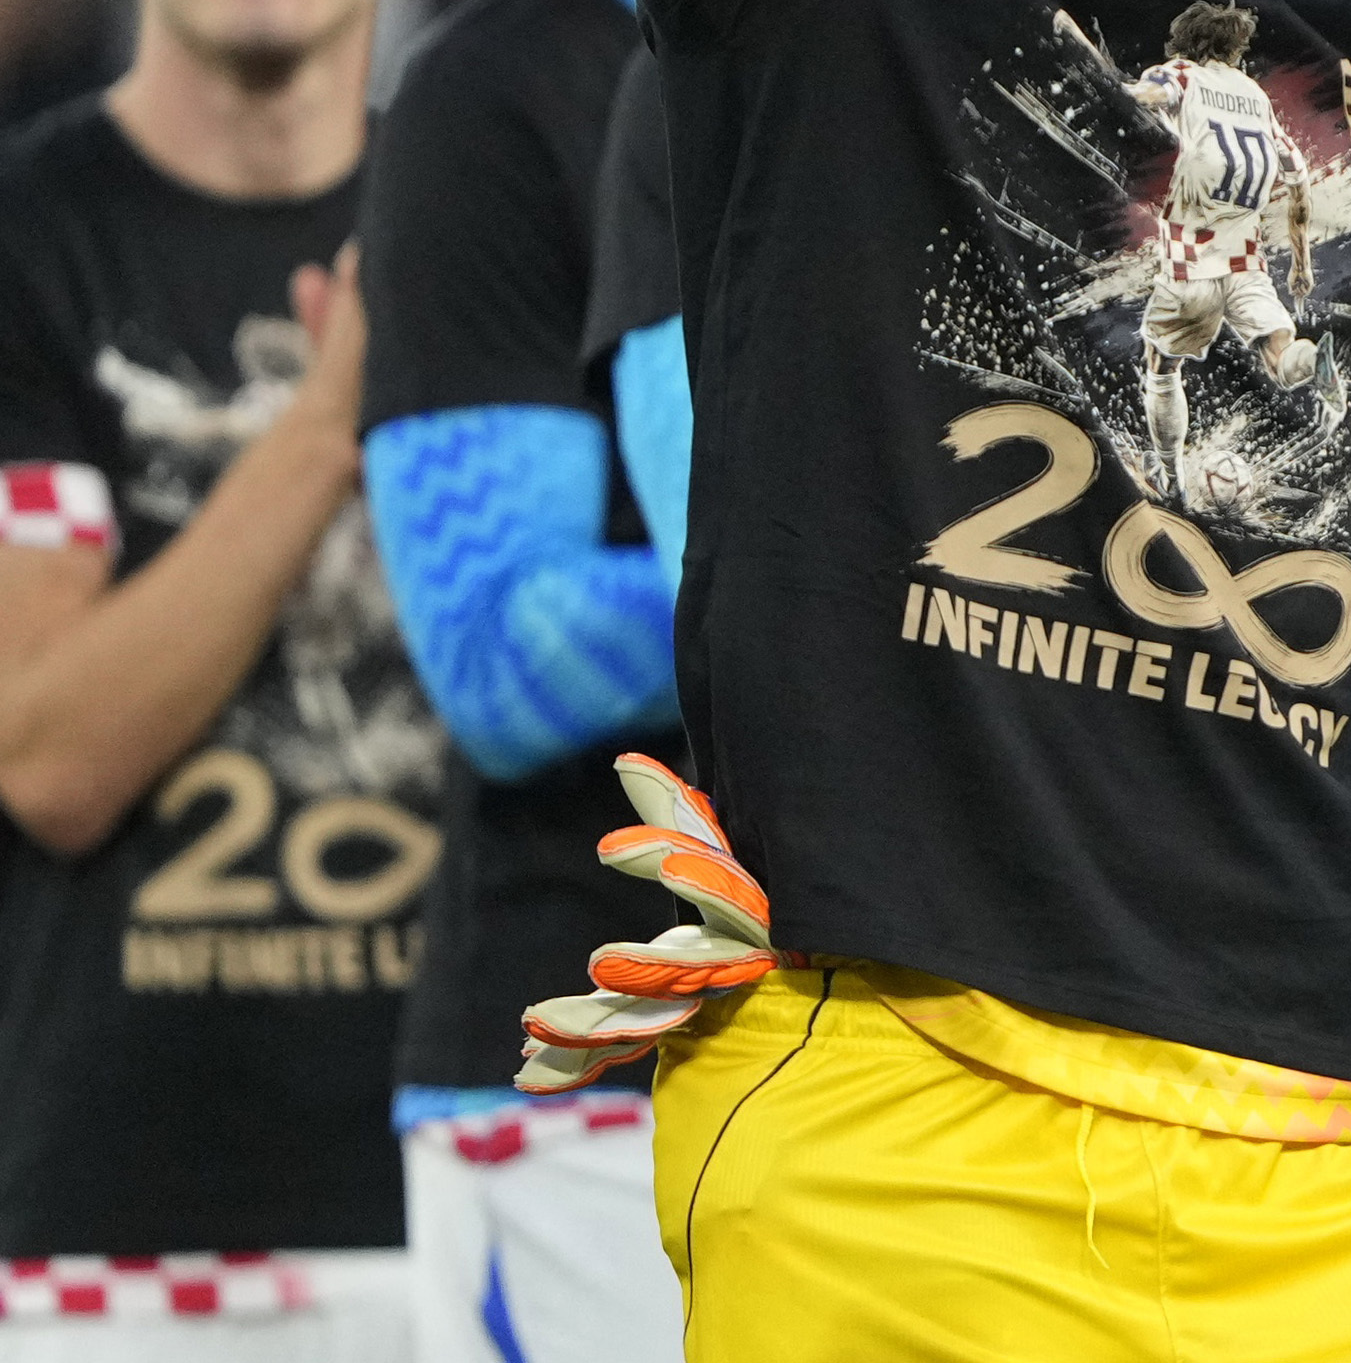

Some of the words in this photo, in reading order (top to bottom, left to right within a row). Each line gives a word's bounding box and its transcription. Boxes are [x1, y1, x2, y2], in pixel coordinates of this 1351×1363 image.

[1207, 118, 1263, 211] 10
[901, 581, 1173, 702] INFINITE
[1184, 650, 1350, 769] LECY
